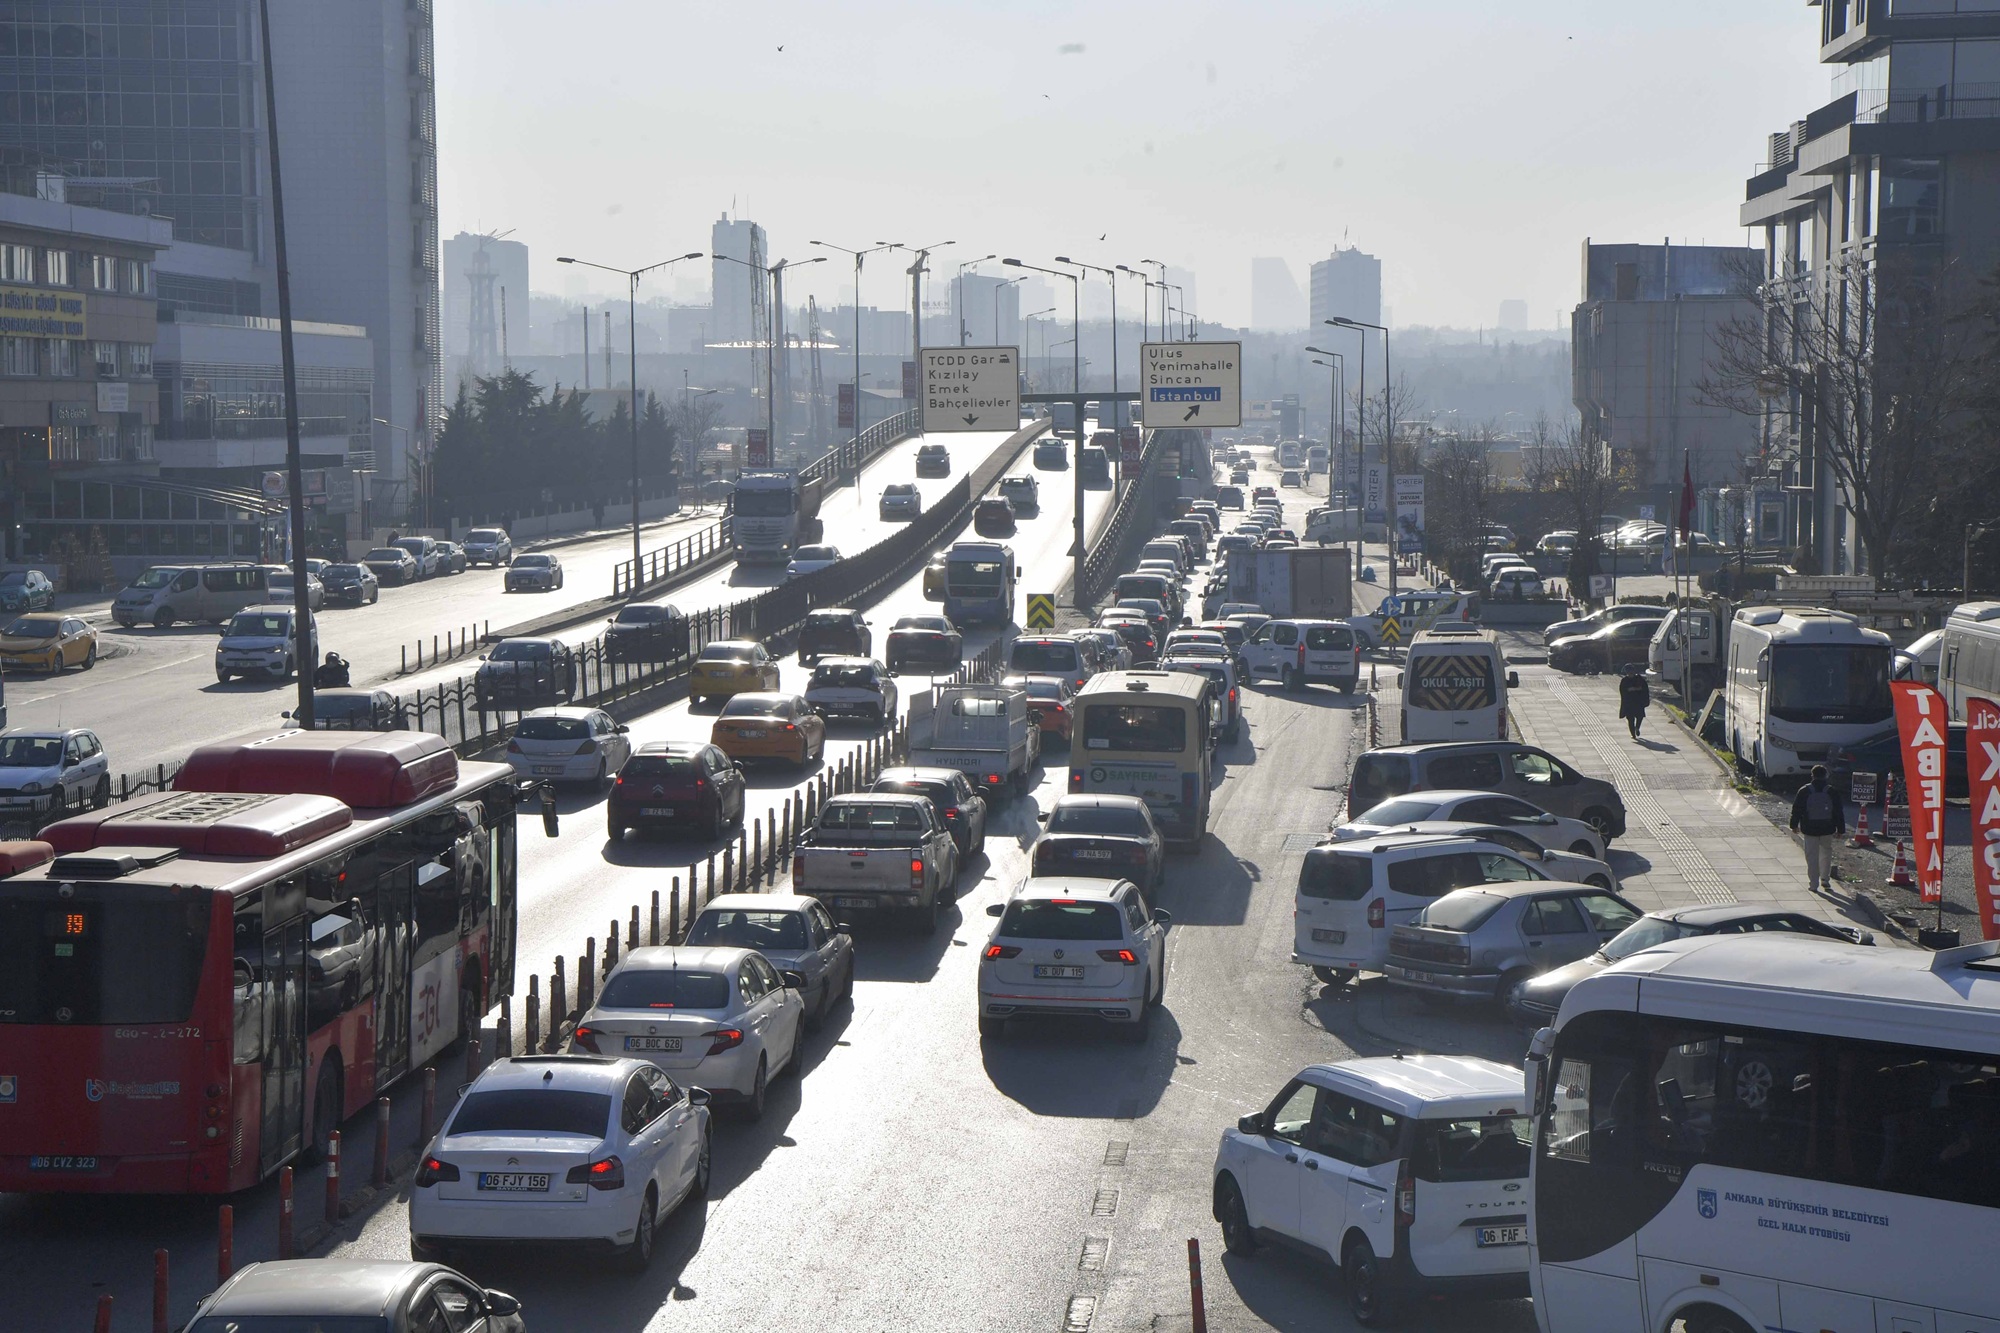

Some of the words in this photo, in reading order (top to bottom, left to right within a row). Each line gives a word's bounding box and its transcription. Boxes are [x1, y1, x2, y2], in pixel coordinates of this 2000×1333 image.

[1149, 348, 1183, 358] Ulus
[928, 355, 966, 366] TCDD
[970, 355, 995, 365] Gar
[1150, 360, 1233, 371] Yenimahalle
[928, 369, 979, 382] Kızılay
[1150, 374, 1202, 384] Sincan
[929, 384, 970, 394] Emek
[1153, 388, 1218, 401] İstanbul
[929, 397, 1011, 409] Bahçelievler
[748, 452, 765, 464] 50
[1122, 450, 1139, 461] 50
[1368, 469, 1380, 511] CRITER
[1590, 576, 1607, 597] P
[1421, 678, 1449, 688] OKUL
[1454, 677, 1485, 690] TAŞITI
[935, 757, 982, 766] HYUNDAI
[1109, 770, 1158, 781] SAYREM
[630, 1038, 641, 1048] 06
[664, 1039, 680, 1049] 628
[37, 1157, 50, 1168] 06
[53, 1157, 72, 1168] CVZ
[76, 1157, 96, 1168] 323
[486, 1174, 500, 1186] 06
[502, 1175, 525, 1187] FJY
[528, 1175, 547, 1187] 156
[1724, 1192, 1764, 1206] ANKARA
[1767, 1197, 1829, 1217] BÜYÜKŞEHİR
[1832, 1208, 1889, 1227] BELEDİYESİ
[1757, 1216, 1780, 1230] ÖZEL
[1782, 1222, 1807, 1235] HALK
[1809, 1227, 1851, 1242] OTOBÜSÜ
[1483, 1230, 1496, 1243] 06
[1501, 1228, 1519, 1242] FAF
